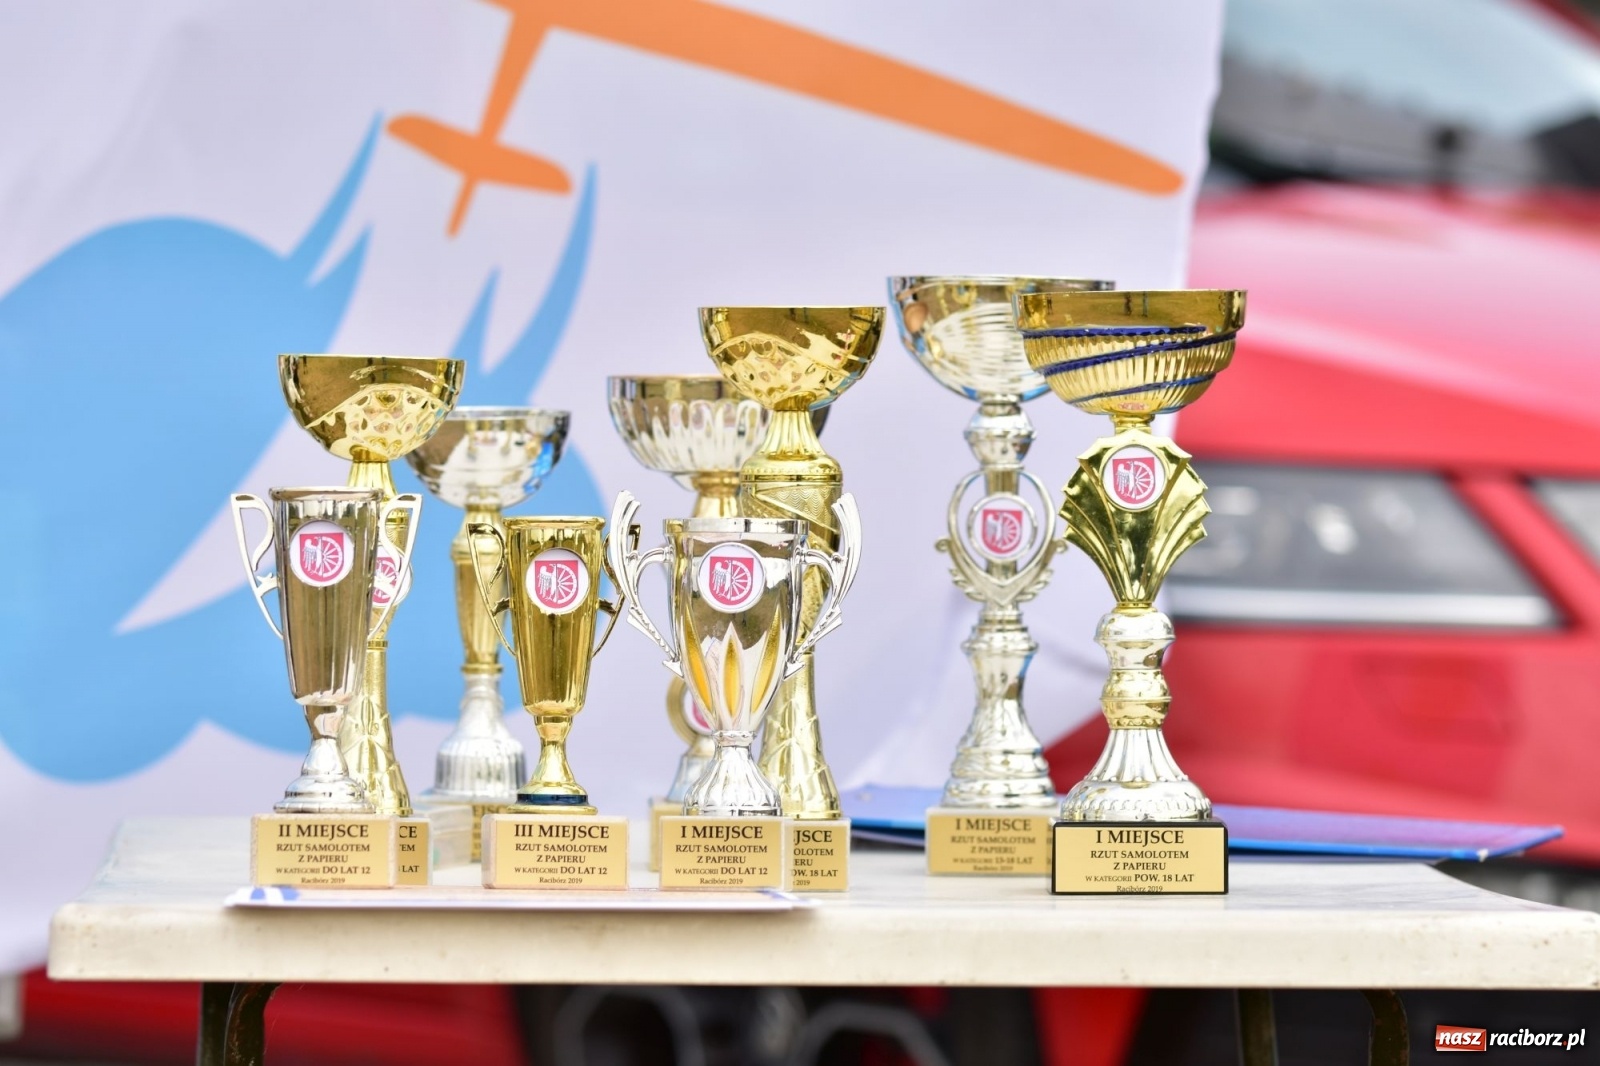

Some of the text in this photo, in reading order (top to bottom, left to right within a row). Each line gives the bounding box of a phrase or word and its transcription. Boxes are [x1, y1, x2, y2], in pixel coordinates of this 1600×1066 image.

[955, 818, 1032, 833] I MIEJSCE
[278, 824, 369, 840] II MIEJSCE
[514, 824, 610, 841] III MIEJSCE
[680, 825, 763, 841] I MIEJSCE
[793, 829, 833, 845] JSCE
[976, 836, 1036, 844] SAMOLOTEM
[1096, 829, 1184, 847] I MIEJSCE
[276, 843, 370, 852] RZUT SAMOLOTEM
[515, 843, 607, 853] RZUT SAMOLOTEM
[675, 844, 768, 853] RZUT SAMOLOTEM
[793, 847, 834, 856] OLOTEM
[978, 846, 1016, 854] PAPIERU
[298, 854, 349, 863] Z PAPIERU
[536, 854, 586, 863] Z PAPIERU
[1090, 850, 1189, 859] RZUT SAMOLOTEM
[696, 856, 746, 864] Z PAPIERU
[322, 866, 338, 874] DO
[340, 866, 359, 874] LAT
[361, 866, 371, 874] 12
[402, 865, 420, 873] LAT
[560, 866, 576, 874] DO
[577, 866, 596, 874] LAT
[598, 867, 608, 875] 12
[720, 867, 736, 875] DO
[738, 867, 757, 875] LAT
[759, 867, 768, 875] 12
[1113, 862, 1166, 871] Z PAPIERU
[791, 869, 839, 877] OW. 18 LAT
[1134, 873, 1160, 882] POW.
[1162, 874, 1173, 882] 18
[1175, 874, 1194, 882] LAT
[699, 877, 727, 885] Racibórz
[1116, 885, 1146, 893] Racibórz
